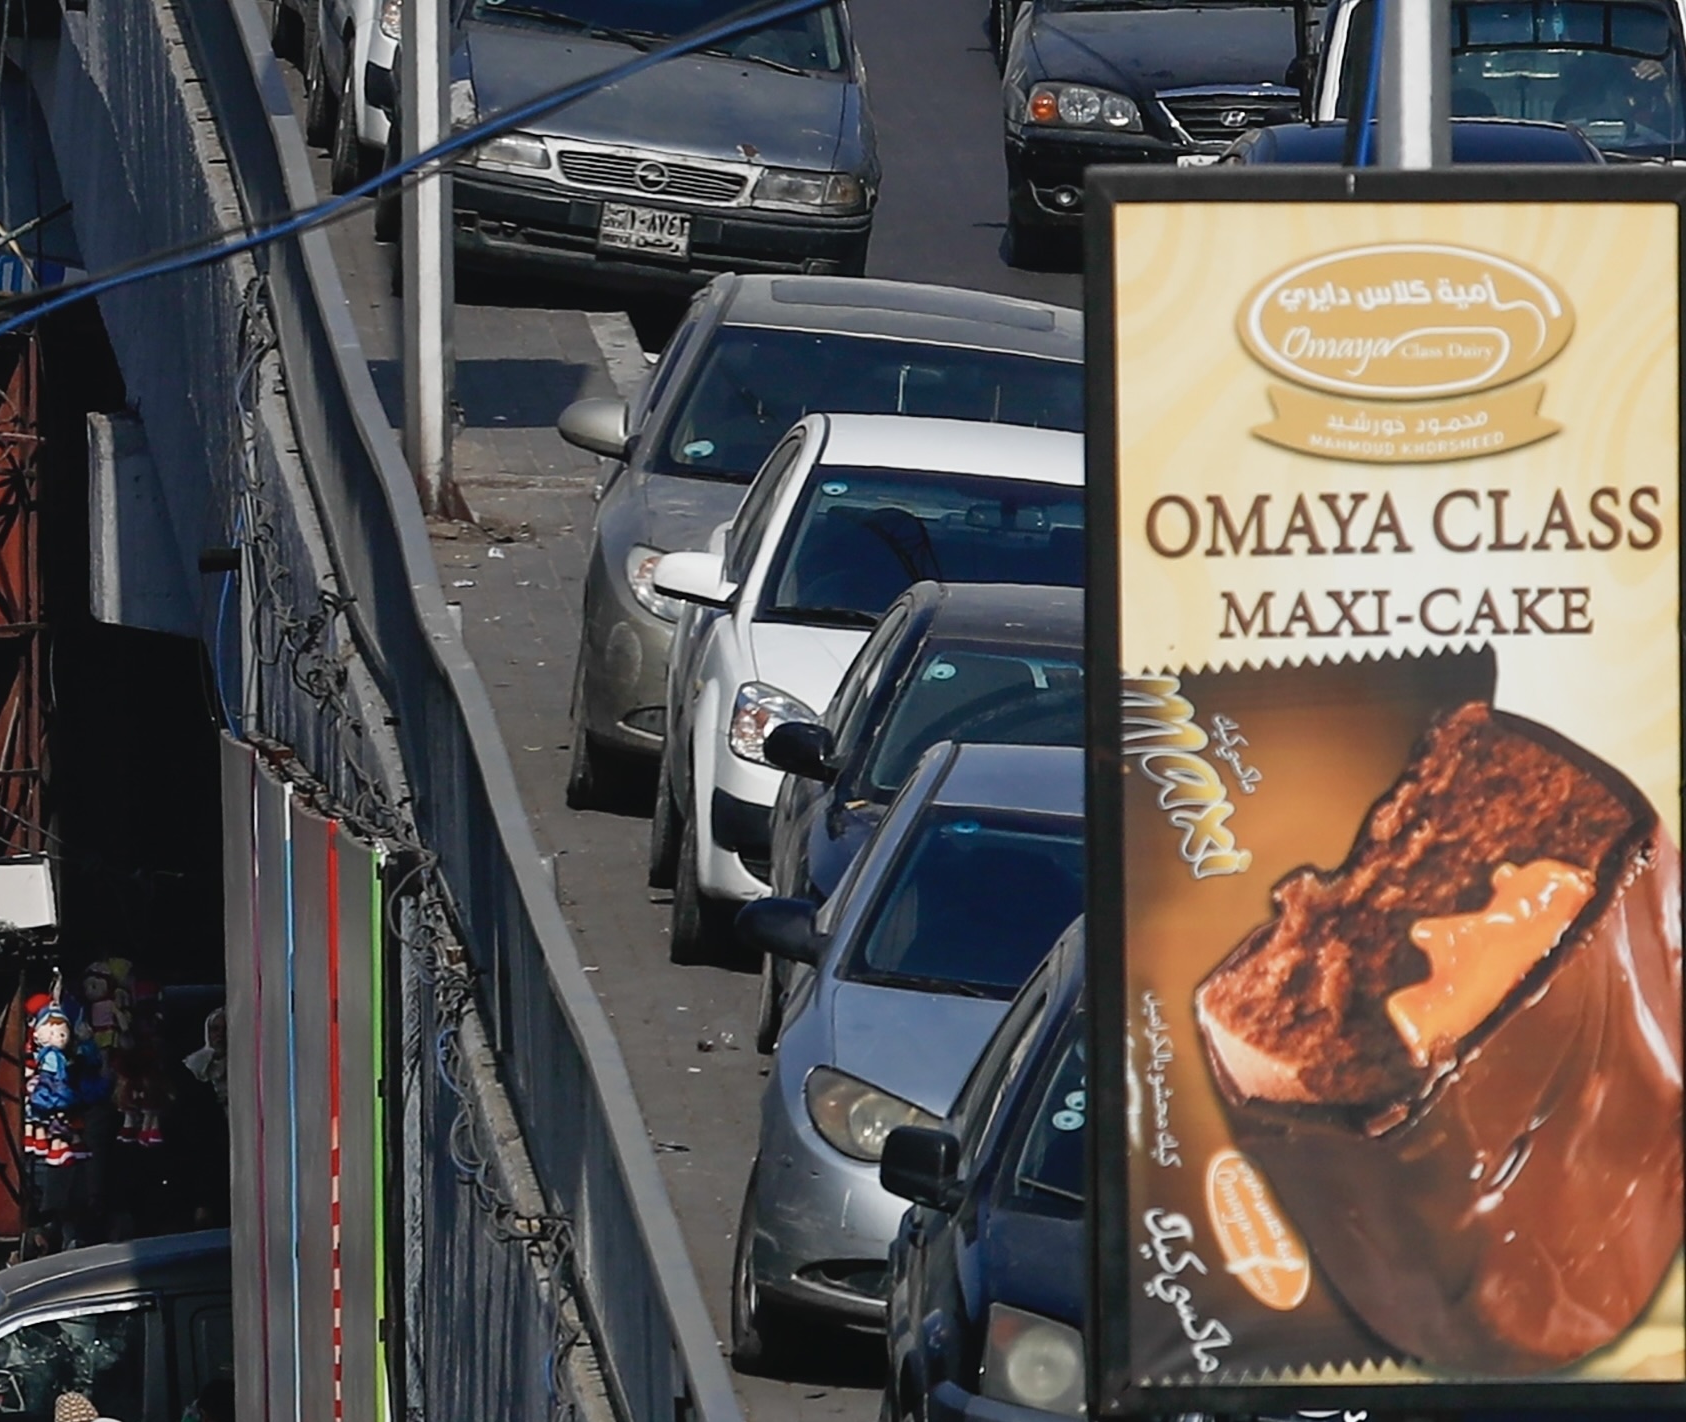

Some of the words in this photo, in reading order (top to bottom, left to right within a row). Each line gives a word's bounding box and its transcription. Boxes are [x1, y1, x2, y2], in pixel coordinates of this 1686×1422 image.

[1278, 281, 1351, 312] دايري
[1356, 279, 1433, 311] كلاس
[1437, 273, 1501, 311] أمية
[1284, 325, 1397, 377] Omaya
[1401, 343, 1443, 359] Class
[1447, 343, 1494, 361] Dairy
[1327, 411, 1406, 437] خورشيد
[1415, 410, 1489, 436] محمود
[1309, 433, 1395, 456] MAHMOUD
[1402, 431, 1504, 455] KHORSHEED
[1145, 490, 1415, 558] OMAYA
[1432, 485, 1663, 552] CLASS
[1217, 585, 1594, 638] MAXI-CAKE
